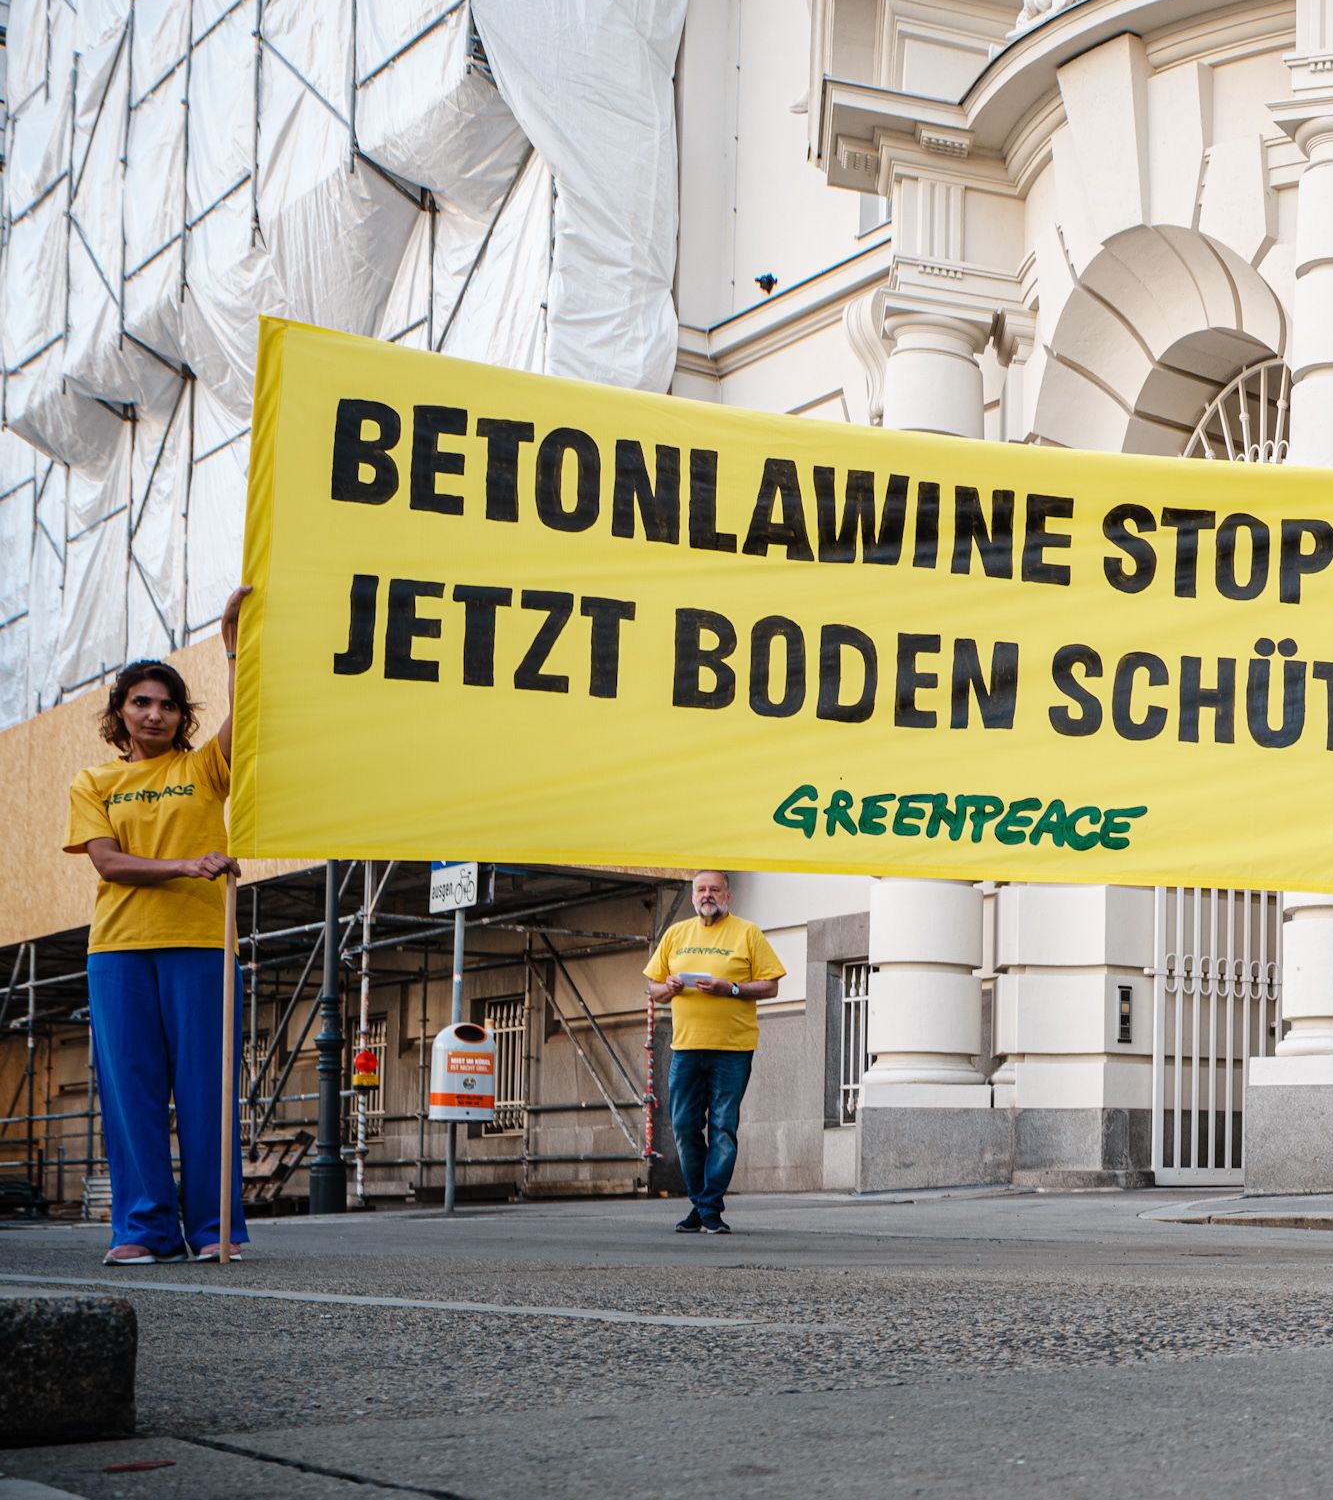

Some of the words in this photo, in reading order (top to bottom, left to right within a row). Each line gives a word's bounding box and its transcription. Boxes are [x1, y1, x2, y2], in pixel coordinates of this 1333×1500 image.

[331, 398, 1074, 587] BETONLAWINE
[333, 574, 636, 699] JETZT
[672, 607, 1019, 730] BODEN
[102, 784, 196, 806] REENPACE
[773, 784, 1148, 851] GREENPEACE
